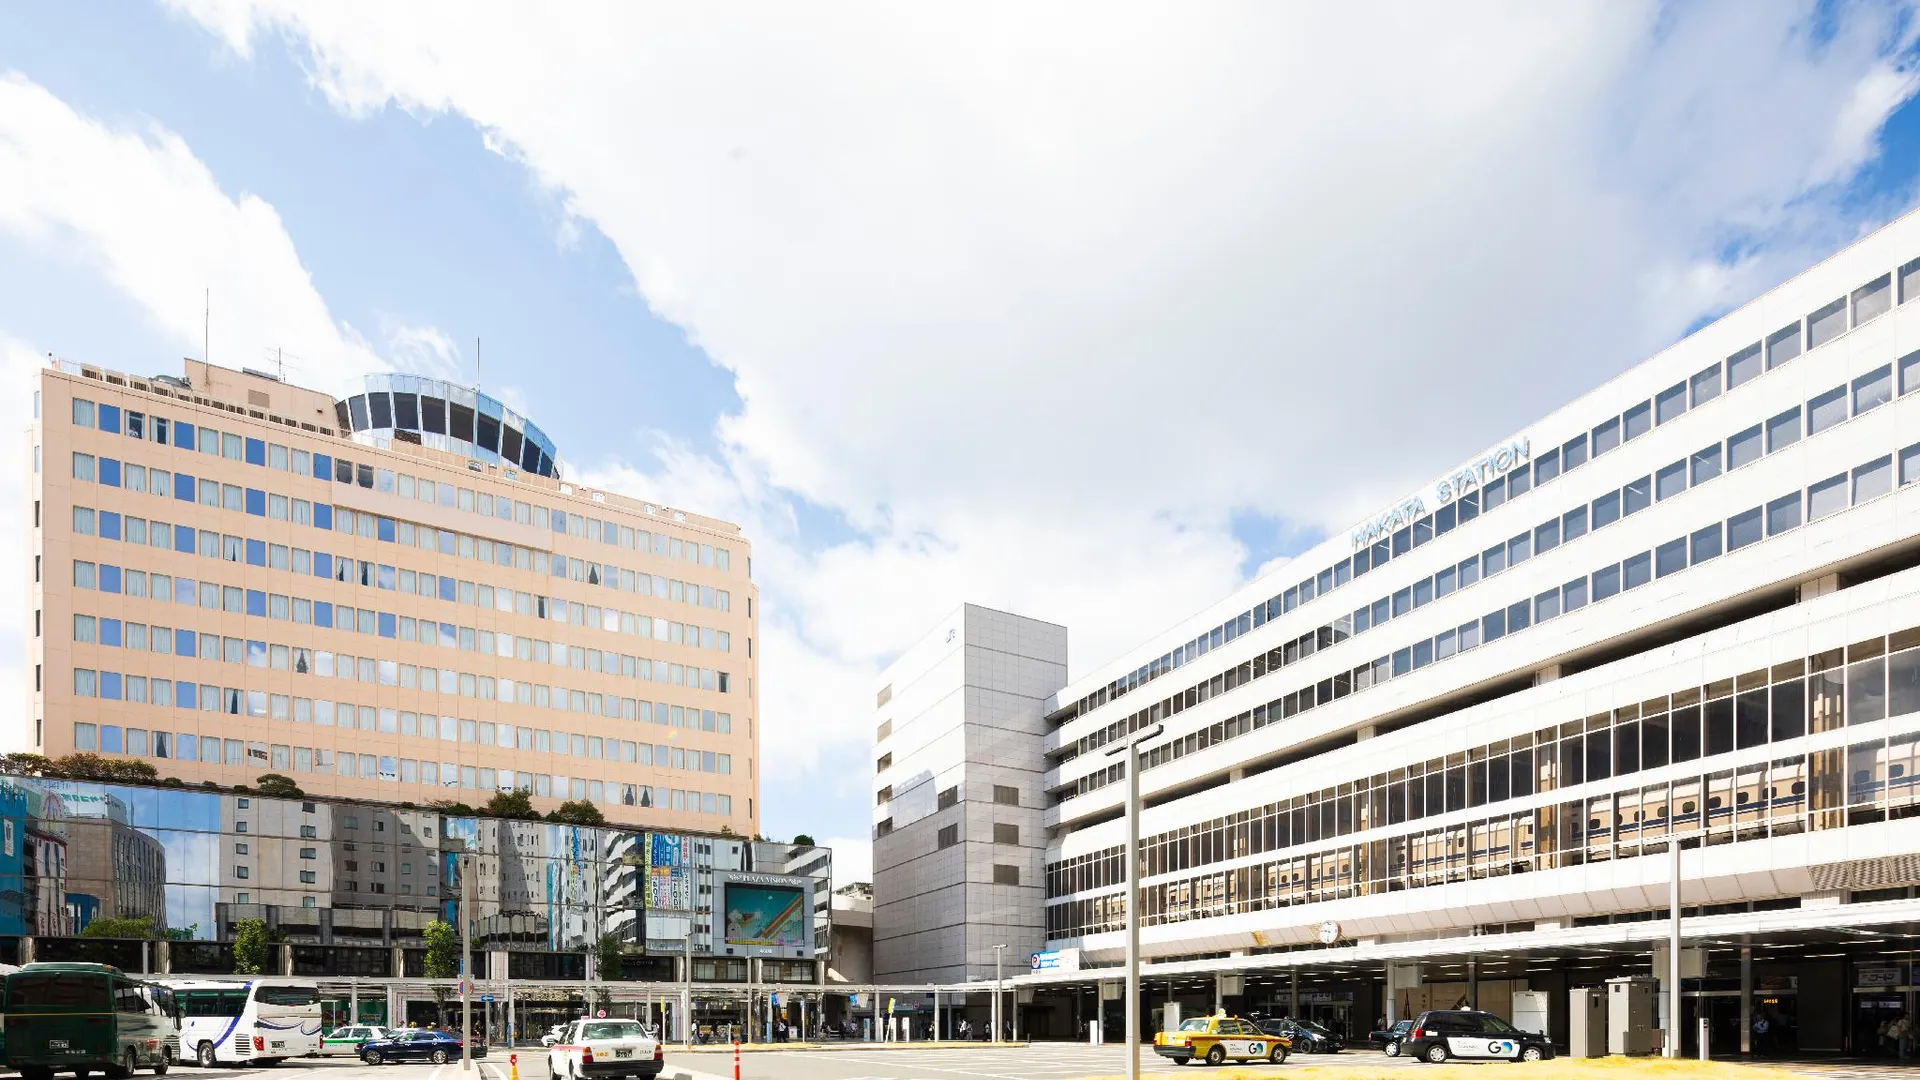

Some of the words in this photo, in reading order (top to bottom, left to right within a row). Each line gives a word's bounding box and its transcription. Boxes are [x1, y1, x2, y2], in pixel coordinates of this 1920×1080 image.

[1351, 495, 1427, 549] HAKATA
[1436, 436, 1530, 504] STATION
[743, 874, 764, 883] PLAZA
[765, 876, 788, 885] VISION
[1487, 1041, 1513, 1054] GO
